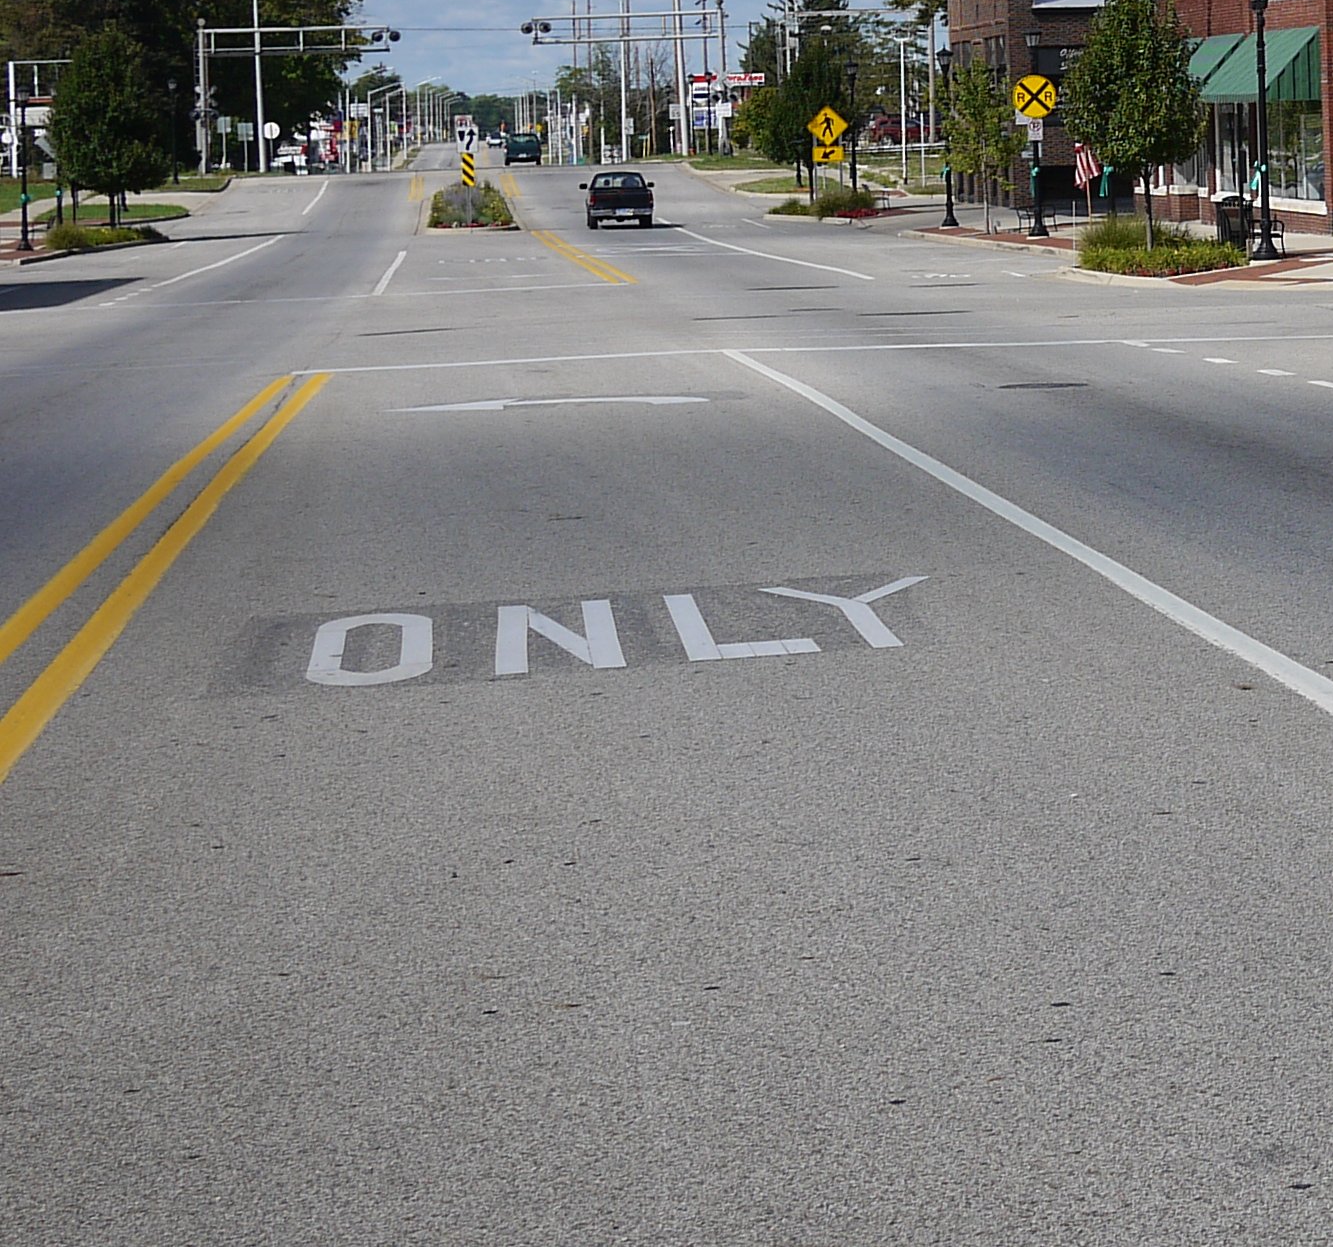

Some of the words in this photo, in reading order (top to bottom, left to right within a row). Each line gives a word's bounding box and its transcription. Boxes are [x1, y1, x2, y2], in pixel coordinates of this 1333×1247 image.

[1017, 92, 1025, 102] R
[1044, 91, 1053, 101] R
[305, 576, 930, 687] ONLY
